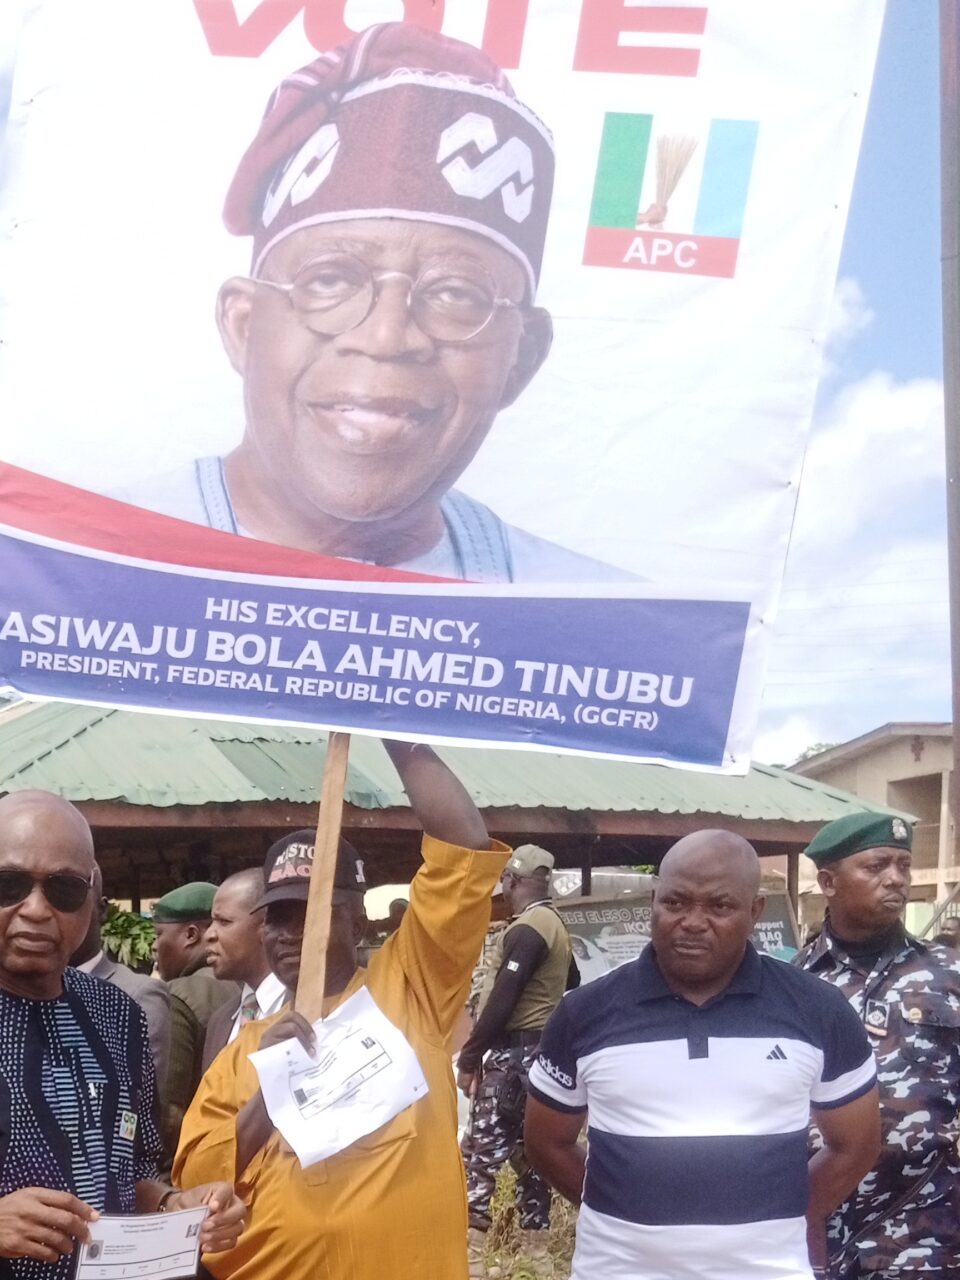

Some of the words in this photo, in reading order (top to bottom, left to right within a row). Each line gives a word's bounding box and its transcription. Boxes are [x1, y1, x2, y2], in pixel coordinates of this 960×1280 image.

[622, 237, 699, 269] APC
[204, 597, 259, 624] HIS
[265, 602, 481, 648] EXCELLENCY,
[20, 650, 161, 684] PRESIDENT,
[167, 665, 279, 694] FEDERAL
[285, 676, 411, 705] REPUBLIC
[414, 689, 451, 709] OF
[454, 694, 567, 724] NIGERIA,
[573, 703, 659, 731] (GCFR)
[204, 630, 328, 672] BOLA
[334, 643, 504, 688] AHMED
[514, 659, 695, 708] TINUBU
[539, 1054, 573, 1087] adidas
